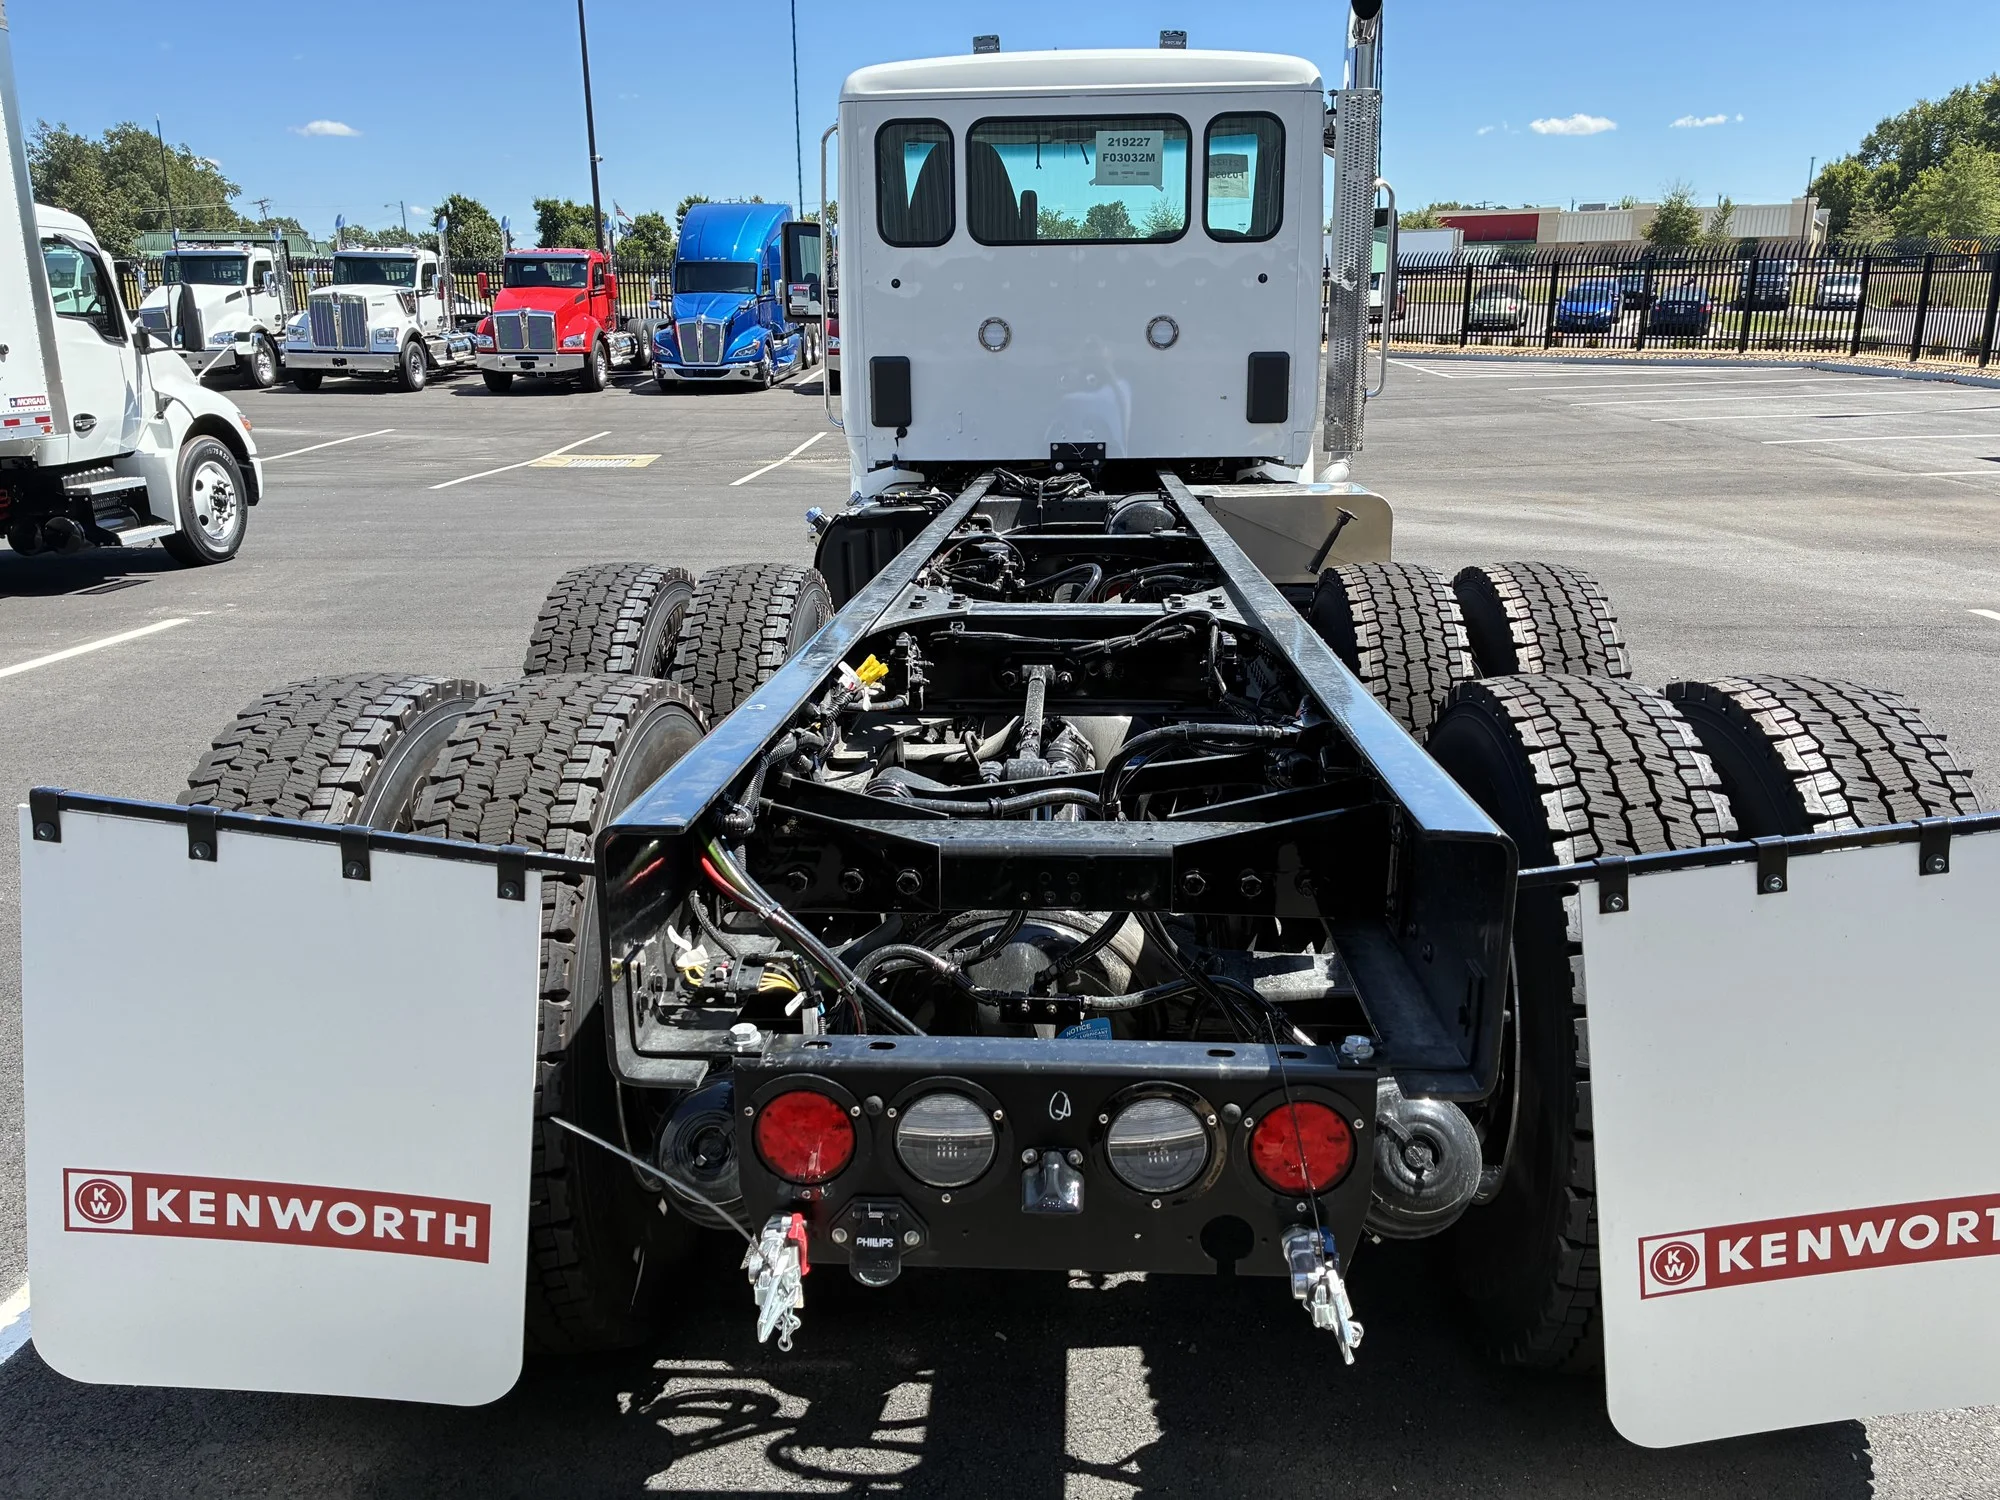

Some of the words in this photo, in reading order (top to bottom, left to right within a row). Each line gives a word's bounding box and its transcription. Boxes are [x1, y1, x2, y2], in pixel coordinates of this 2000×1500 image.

[1107, 137, 1151, 147] 219227
[1102, 153, 1156, 163] F03032M
[16, 397, 46, 406] MORGAN
[1066, 1023, 1092, 1037] NOTICE
[146, 1187, 477, 1248] KENWORTH
[856, 1237, 894, 1248] PHILLIPS
